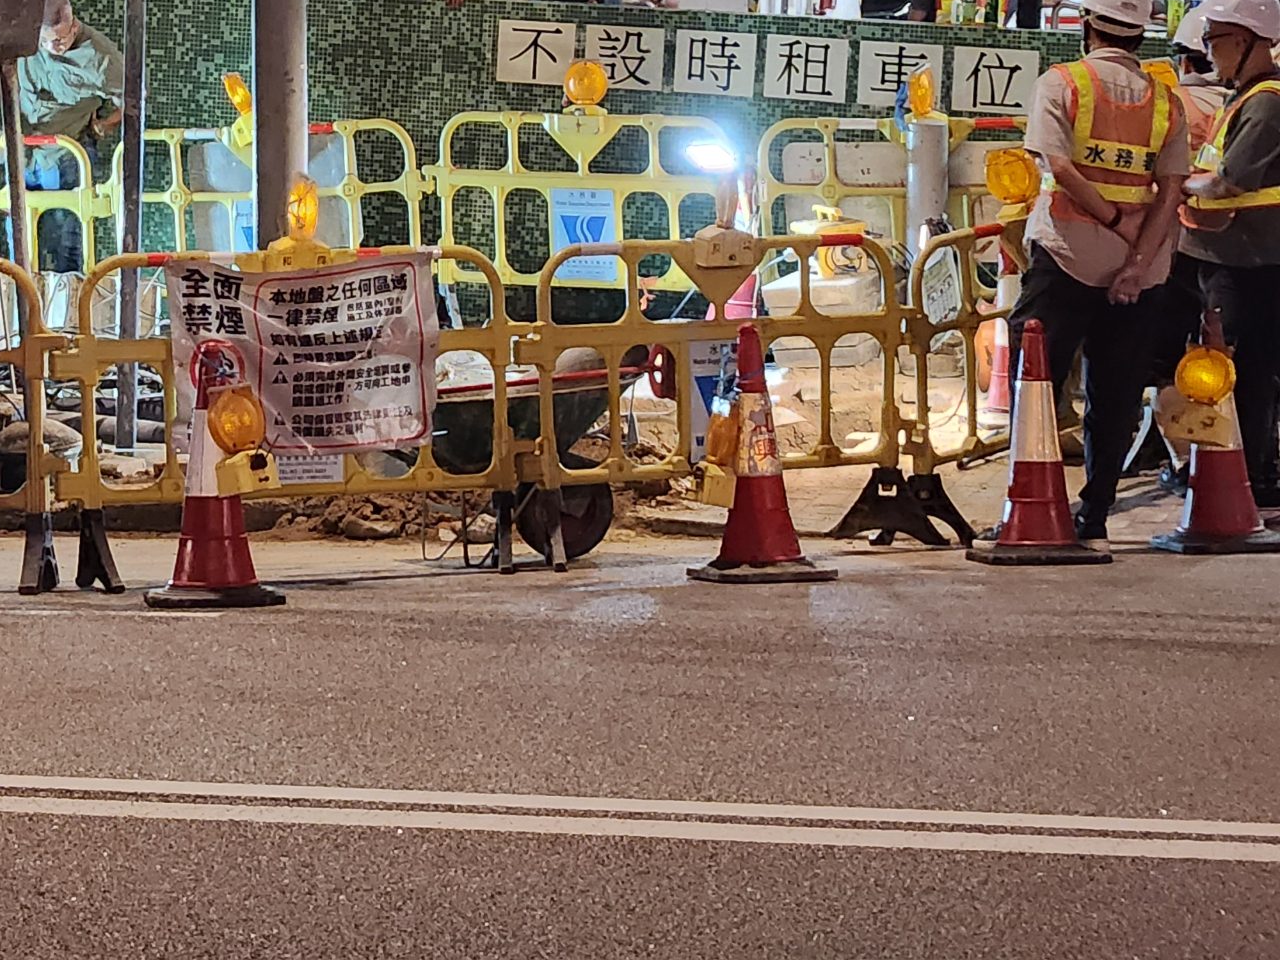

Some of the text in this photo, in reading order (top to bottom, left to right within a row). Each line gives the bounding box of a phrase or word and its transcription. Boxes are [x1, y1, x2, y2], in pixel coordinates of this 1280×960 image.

[509, 26, 1023, 109] 不設時租車位
[181, 268, 244, 302] 全面
[269, 272, 408, 306] 本地盤之任何區域
[182, 303, 247, 336] 禁煙
[267, 305, 340, 327] 一律禁煙
